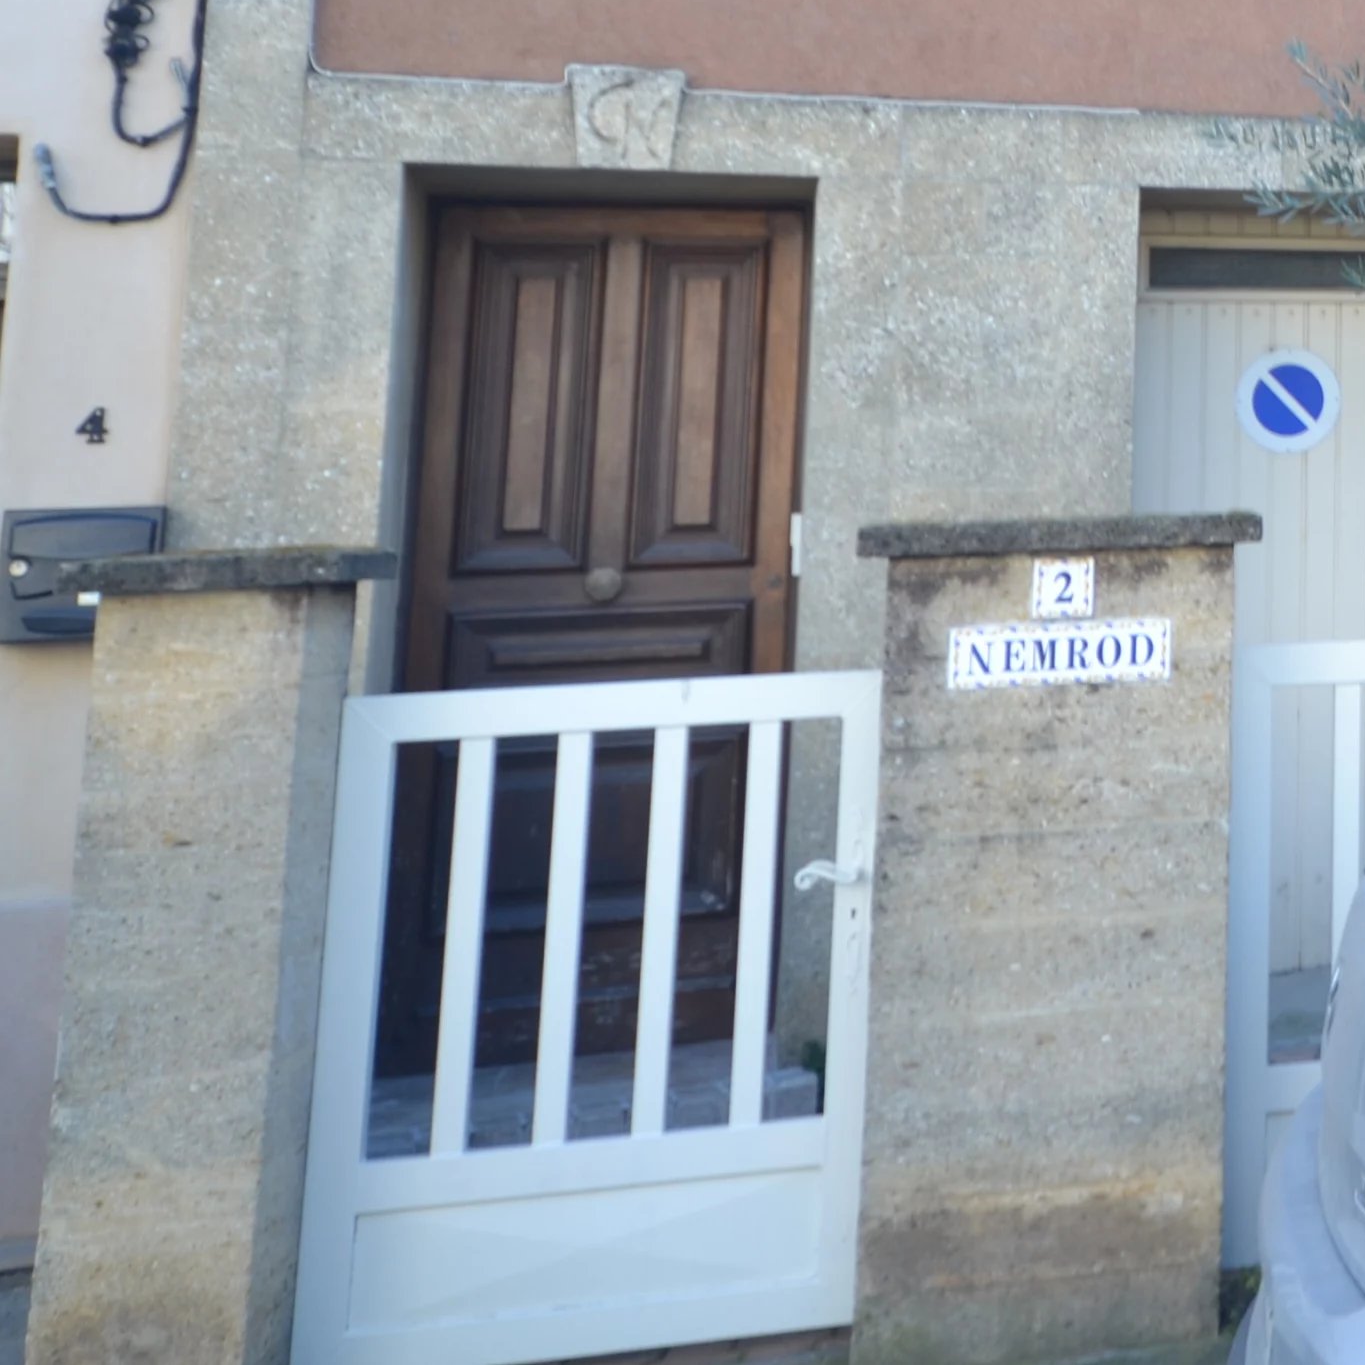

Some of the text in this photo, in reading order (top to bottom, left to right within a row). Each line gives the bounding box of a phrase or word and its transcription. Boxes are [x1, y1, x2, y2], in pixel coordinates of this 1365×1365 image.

[75, 406, 108, 444] 4
[1053, 571, 1074, 603] 2
[967, 633, 1156, 676] NEMROD
